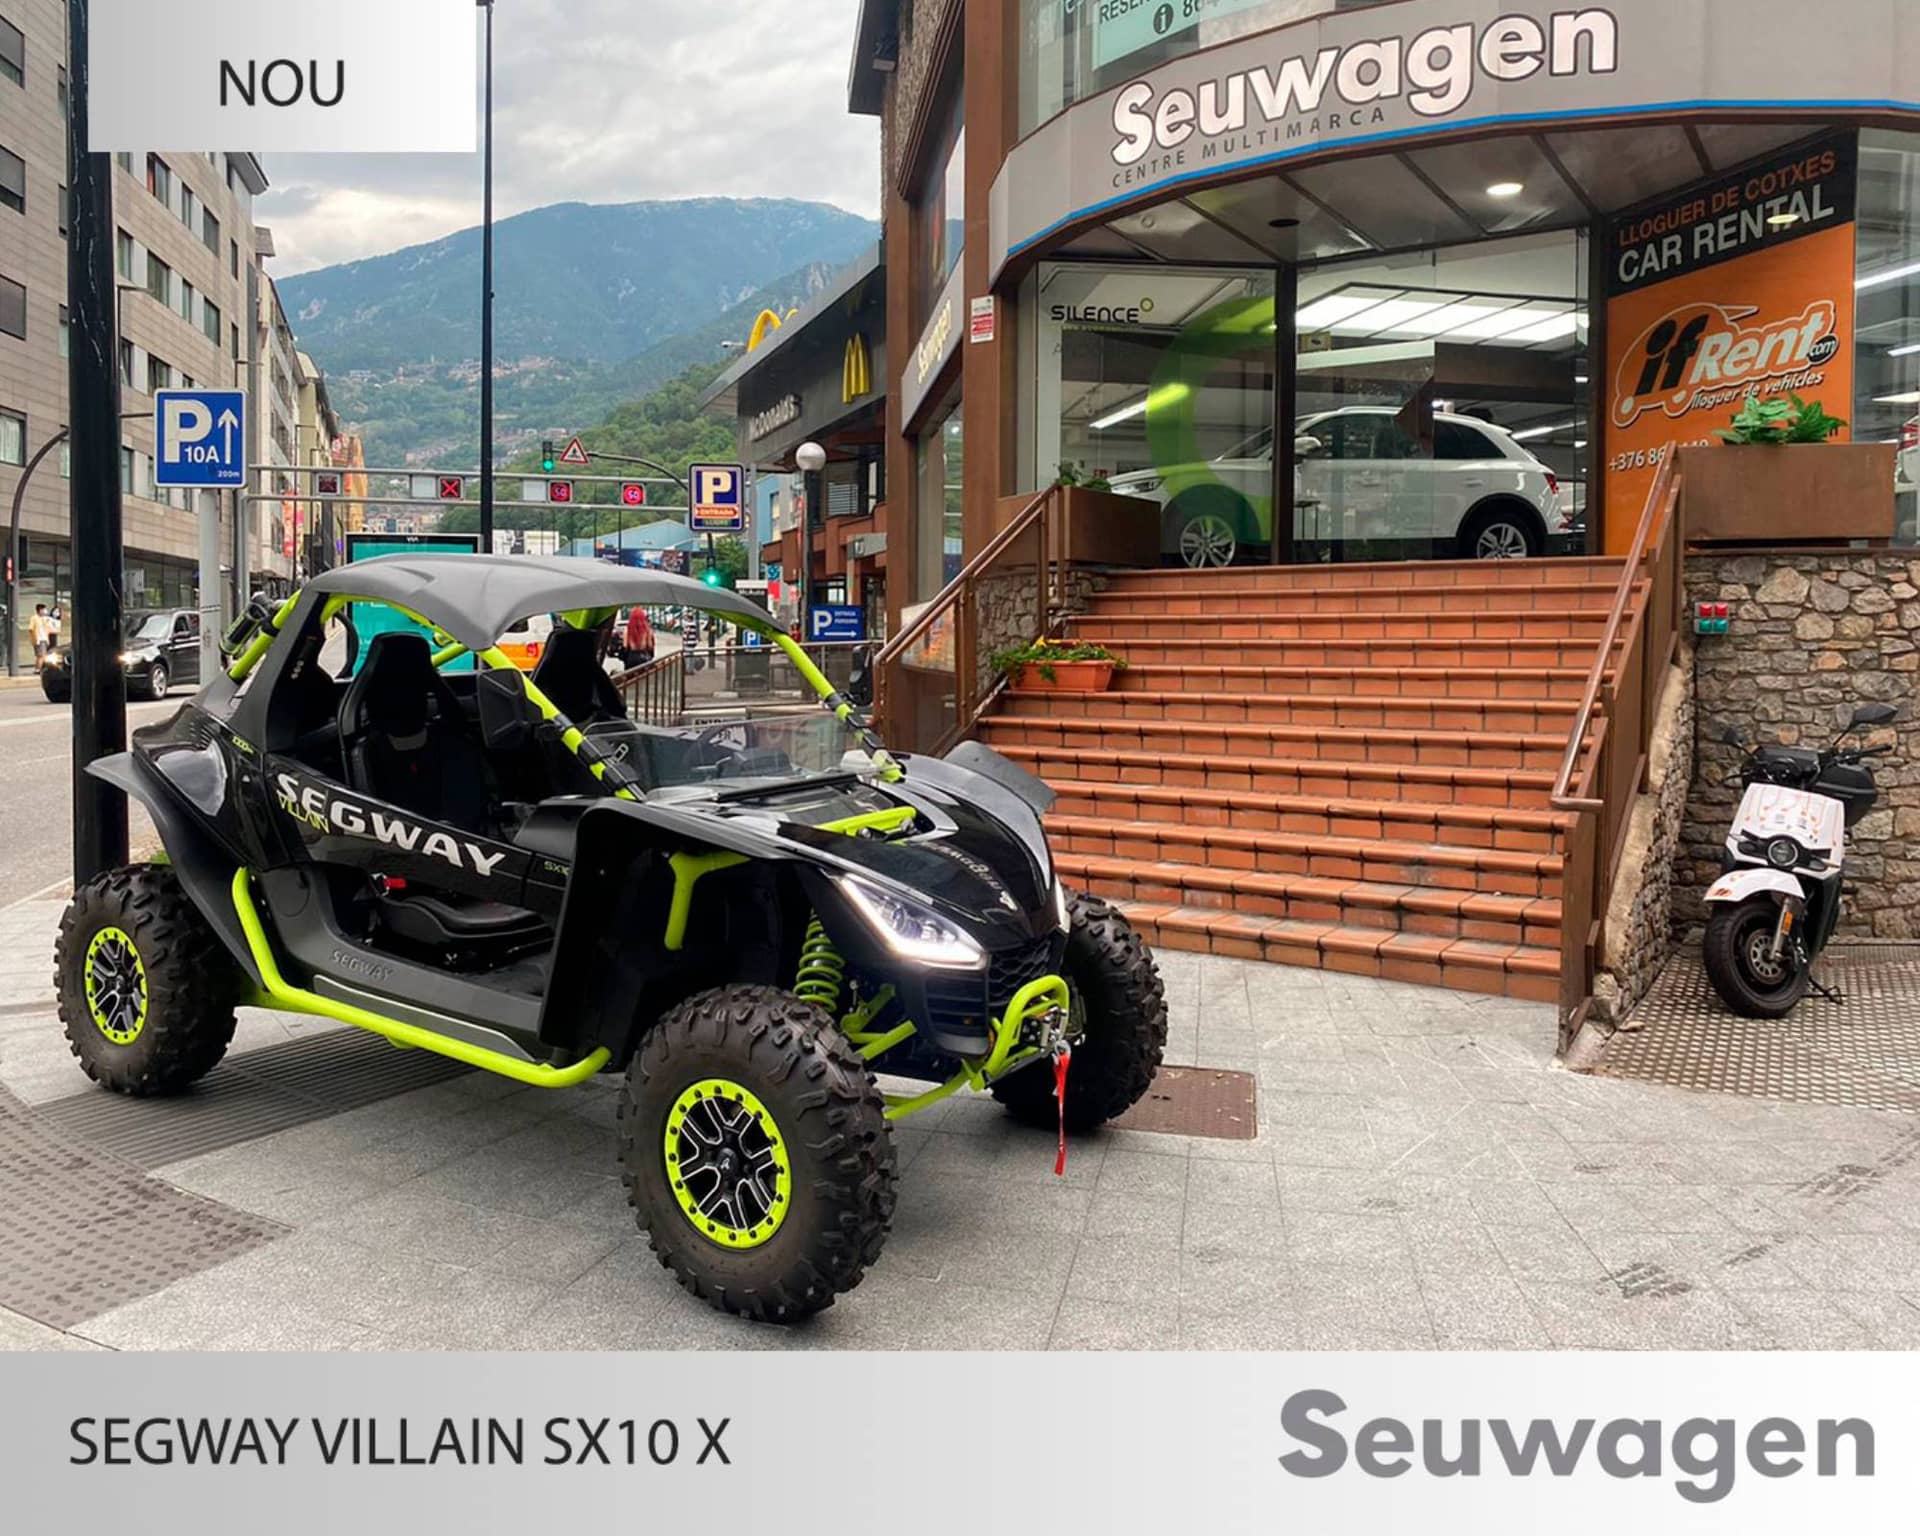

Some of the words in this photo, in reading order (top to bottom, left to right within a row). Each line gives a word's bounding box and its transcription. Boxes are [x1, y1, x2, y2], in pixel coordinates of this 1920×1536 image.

[1111, 8, 1618, 165] Seuwagen
[1112, 150, 1185, 188] CENTRE
[1202, 107, 1385, 159] MULTIMARCA
[1619, 199, 1706, 247] LLOGUER
[1711, 186, 1740, 213] DE
[1744, 151, 1836, 200] COTXES
[1618, 234, 1683, 283] CAR
[1693, 184, 1835, 260] RENTAL
[1051, 305, 1139, 323] SILENCE
[1690, 382, 1738, 409] lloguer
[1741, 380, 1760, 399] de
[1764, 370, 1825, 395] vehicles
[164, 399, 212, 464] P
[184, 445, 220, 464] 10A
[1609, 451, 1645, 472] +376
[217, 470, 240, 479] 200m
[702, 471, 732, 504] P
[814, 610, 833, 636] P
[276, 789, 331, 834] VILLAIN
[276, 773, 506, 877] SEGWAY
[331, 950, 394, 983] SEGWAY
